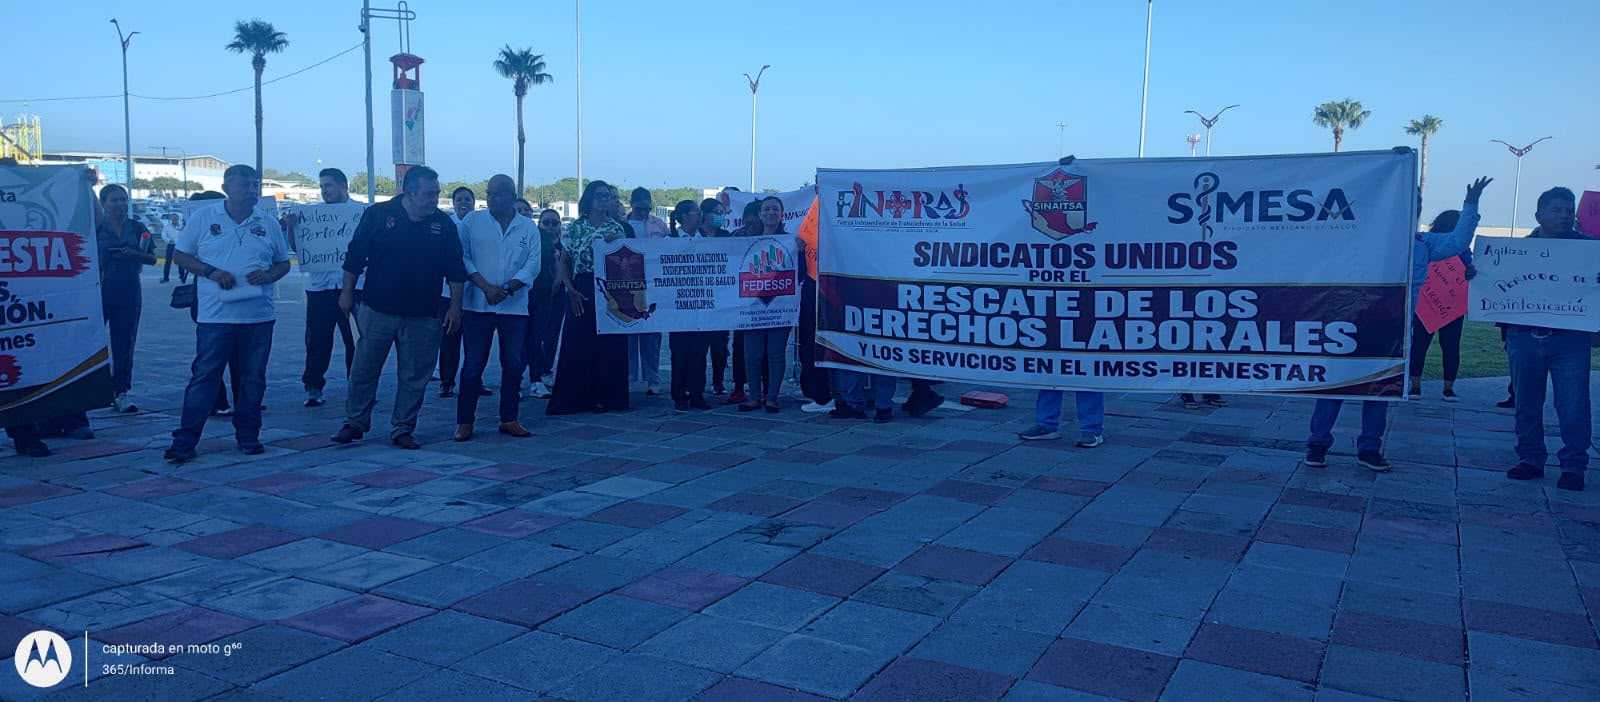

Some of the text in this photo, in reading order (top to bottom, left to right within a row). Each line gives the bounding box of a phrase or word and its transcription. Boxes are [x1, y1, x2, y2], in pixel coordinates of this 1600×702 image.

[1033, 201, 1084, 211] SINAITSA
[660, 253, 728, 264] SINDICATO NACIONAL
[913, 240, 1238, 270] SINDICATOS UNIDOS
[1483, 244, 1550, 266] Agilizar el
[662, 264, 727, 275] INDEPENDIENTE DE
[653, 276, 736, 287] TRABAJADORES DE SALUD
[1029, 270, 1091, 283] POR EL
[607, 281, 646, 290] SINAITSA
[742, 278, 793, 291] FEDESSP
[676, 288, 714, 298] SECCION 01
[675, 300, 715, 310] TAMAULIPAS
[898, 284, 1258, 319] RESCATE DE LOS
[1479, 297, 1588, 312] Desintoxicación
[845, 305, 1358, 354] DERECHOS LABORALES
[858, 342, 1326, 382] Y LOS SERVICIOS EN EL IMSS-BIENESTAR
